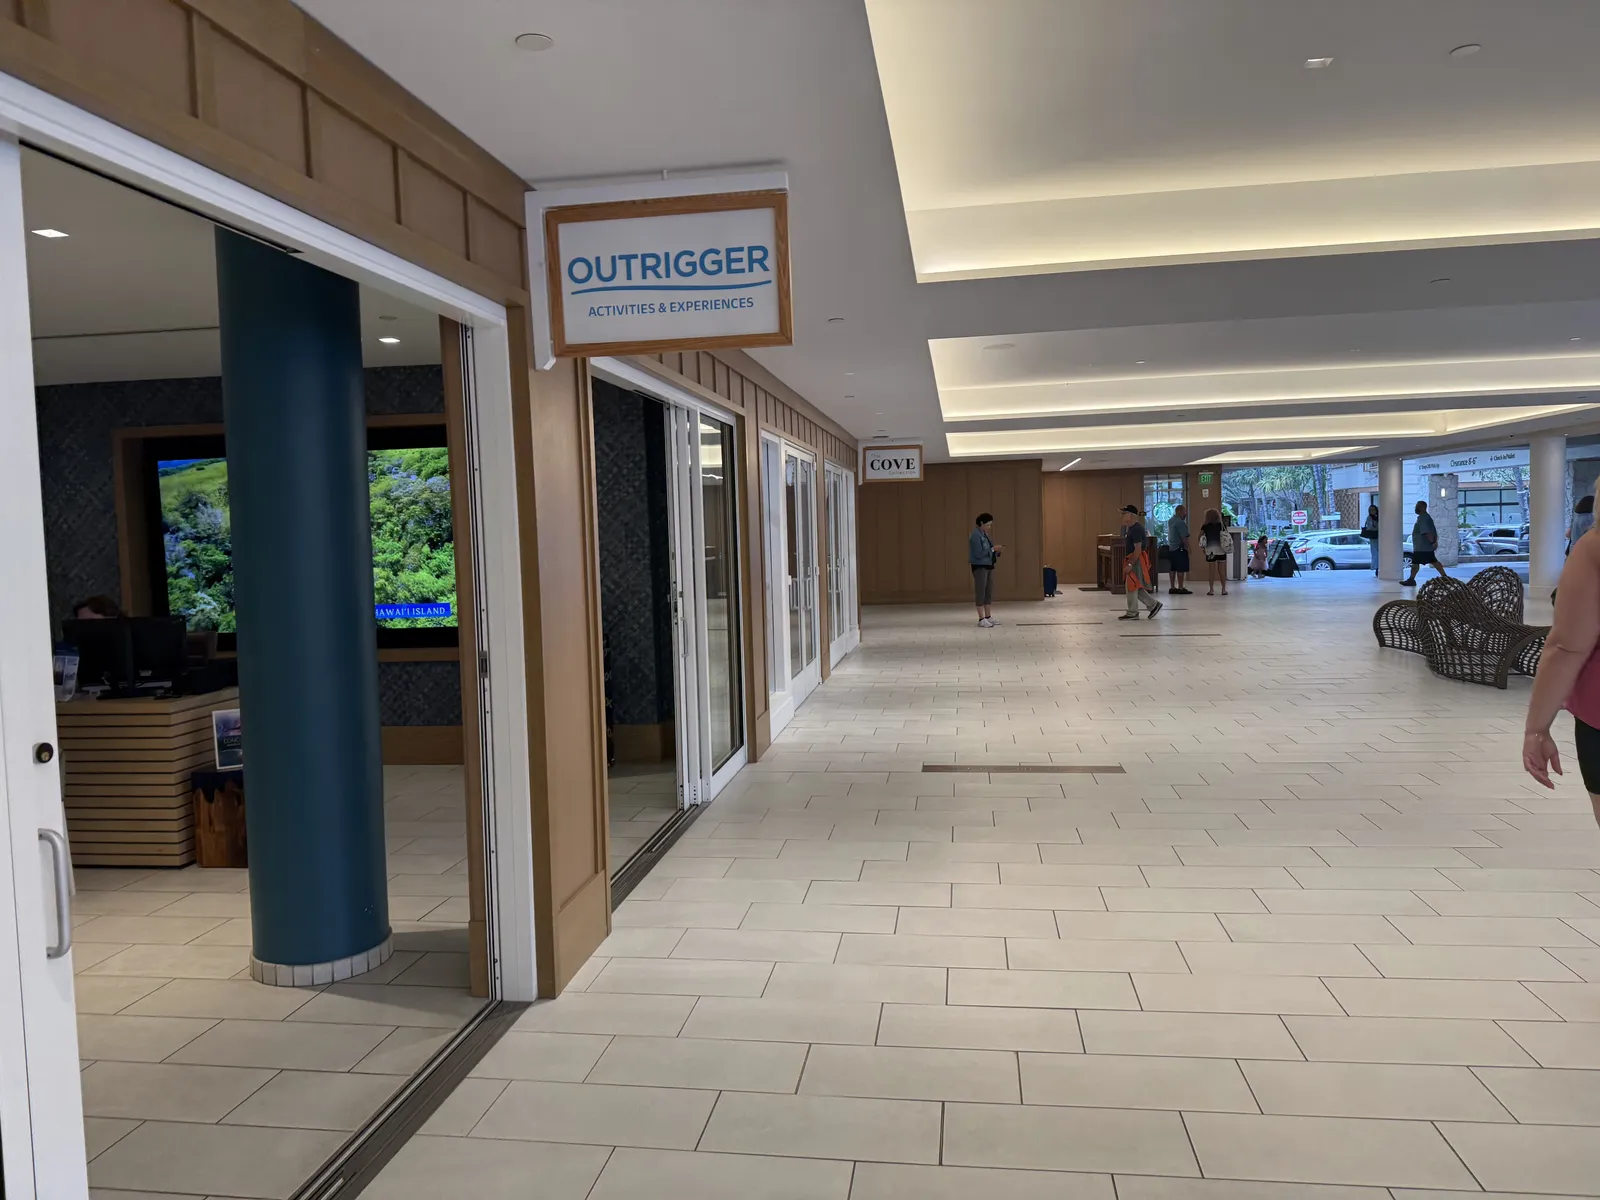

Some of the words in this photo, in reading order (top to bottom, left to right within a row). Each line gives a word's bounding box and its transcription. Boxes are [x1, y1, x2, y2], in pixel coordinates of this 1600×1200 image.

[567, 245, 770, 284] OUTRIGGER
[588, 303, 655, 317] ACTIVITIES
[658, 303, 667, 313] &
[669, 297, 754, 313] EXPERIENCES
[870, 458, 916, 471] COVE
[412, 607, 446, 616] ISLAND
